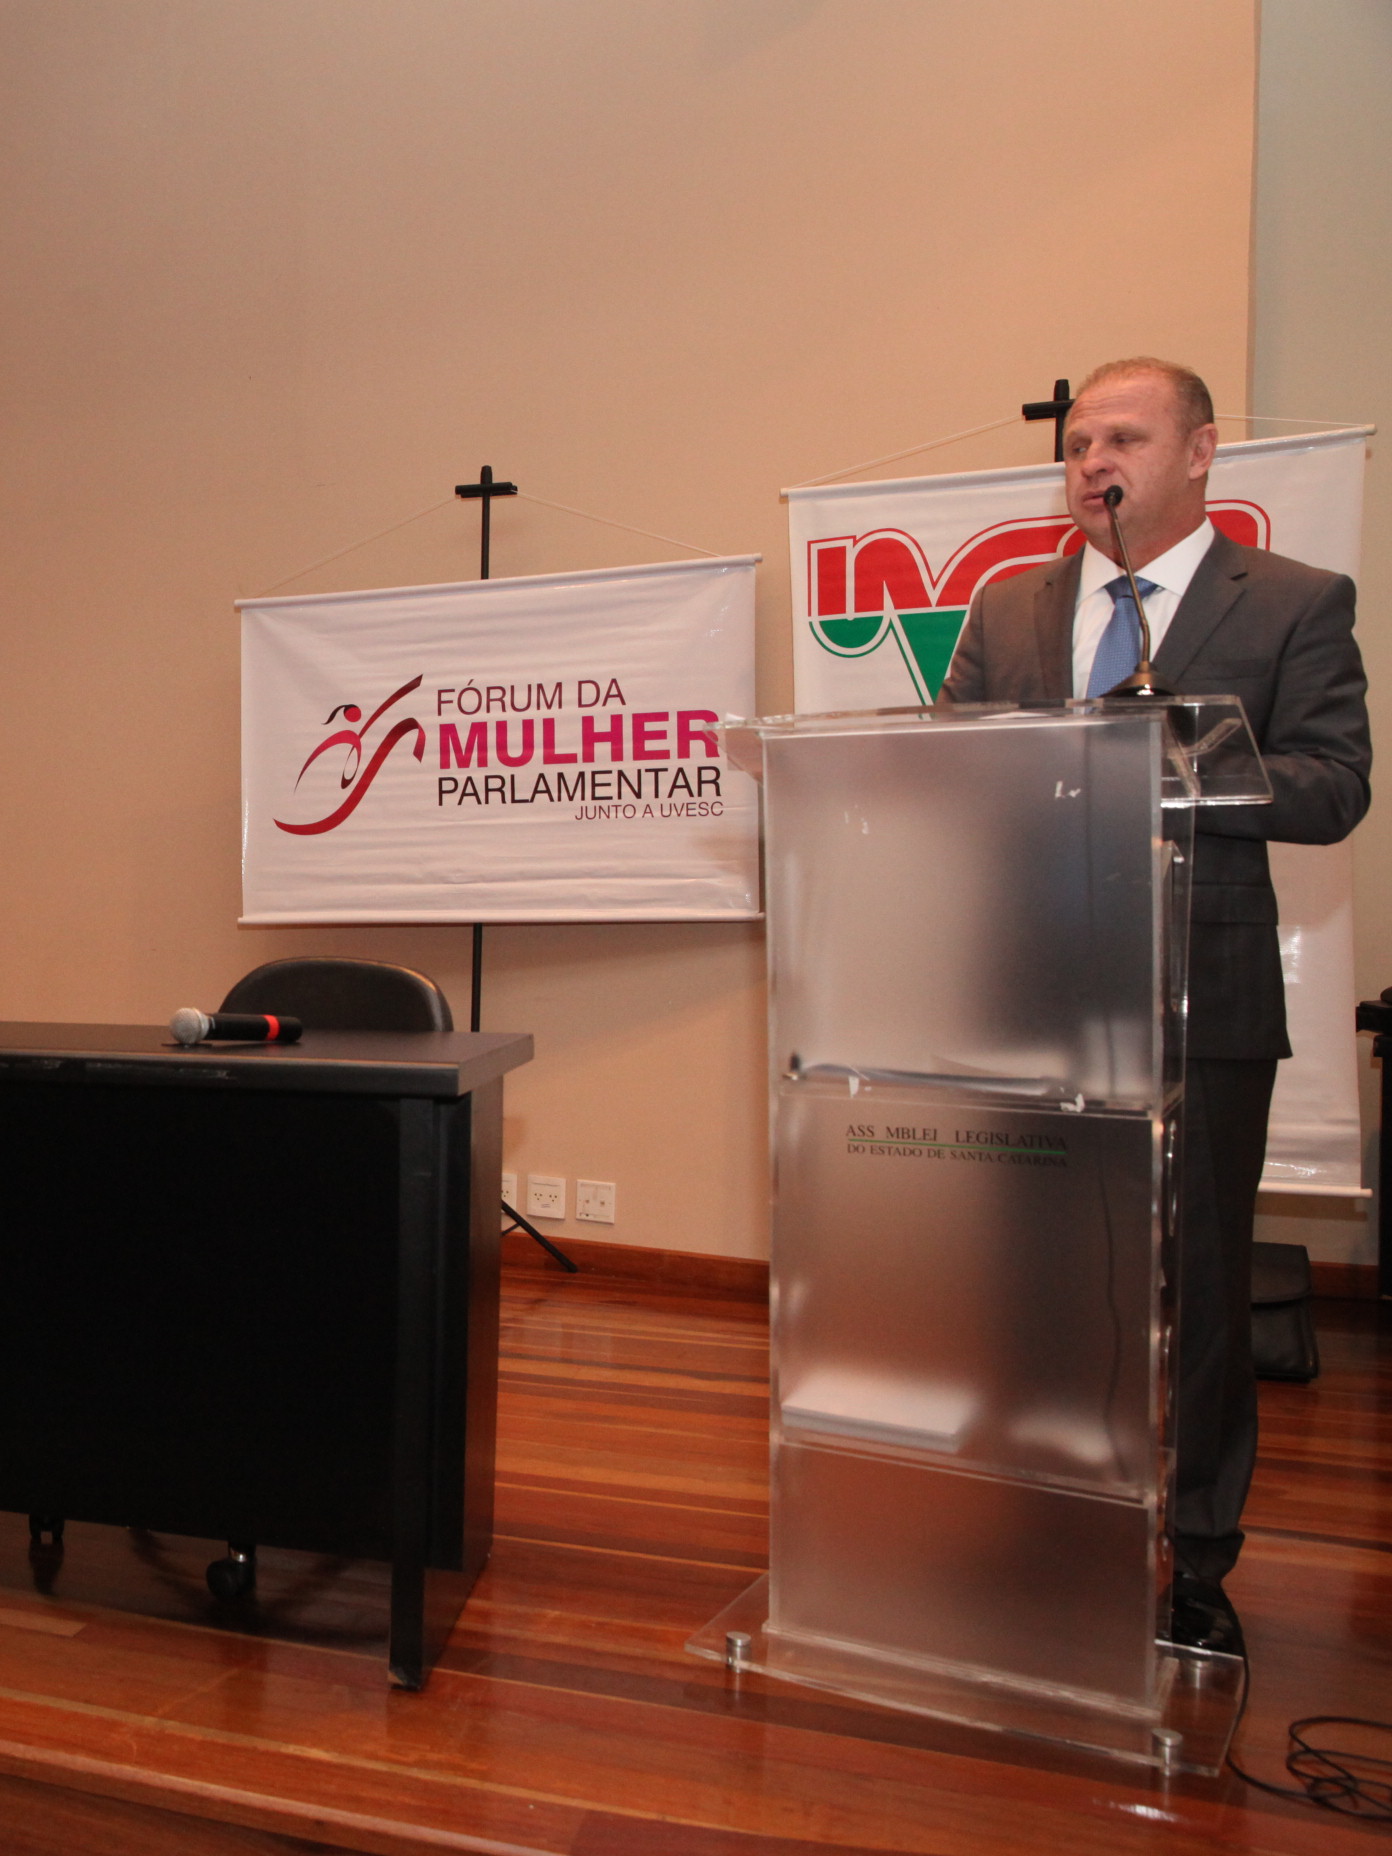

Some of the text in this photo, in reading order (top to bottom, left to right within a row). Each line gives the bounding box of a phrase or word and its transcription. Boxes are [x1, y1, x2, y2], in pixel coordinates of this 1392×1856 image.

[436, 677, 626, 717] FÓRUM DA
[438, 709, 721, 770] MULHER
[437, 765, 722, 806] PARLAMENTAR
[574, 800, 725, 821] JUNTO A UVESC
[847, 1144, 1068, 1168] DO ESTADO DE SANTA CATARINA
[955, 1130, 1068, 1150] LEGISLATIVA
